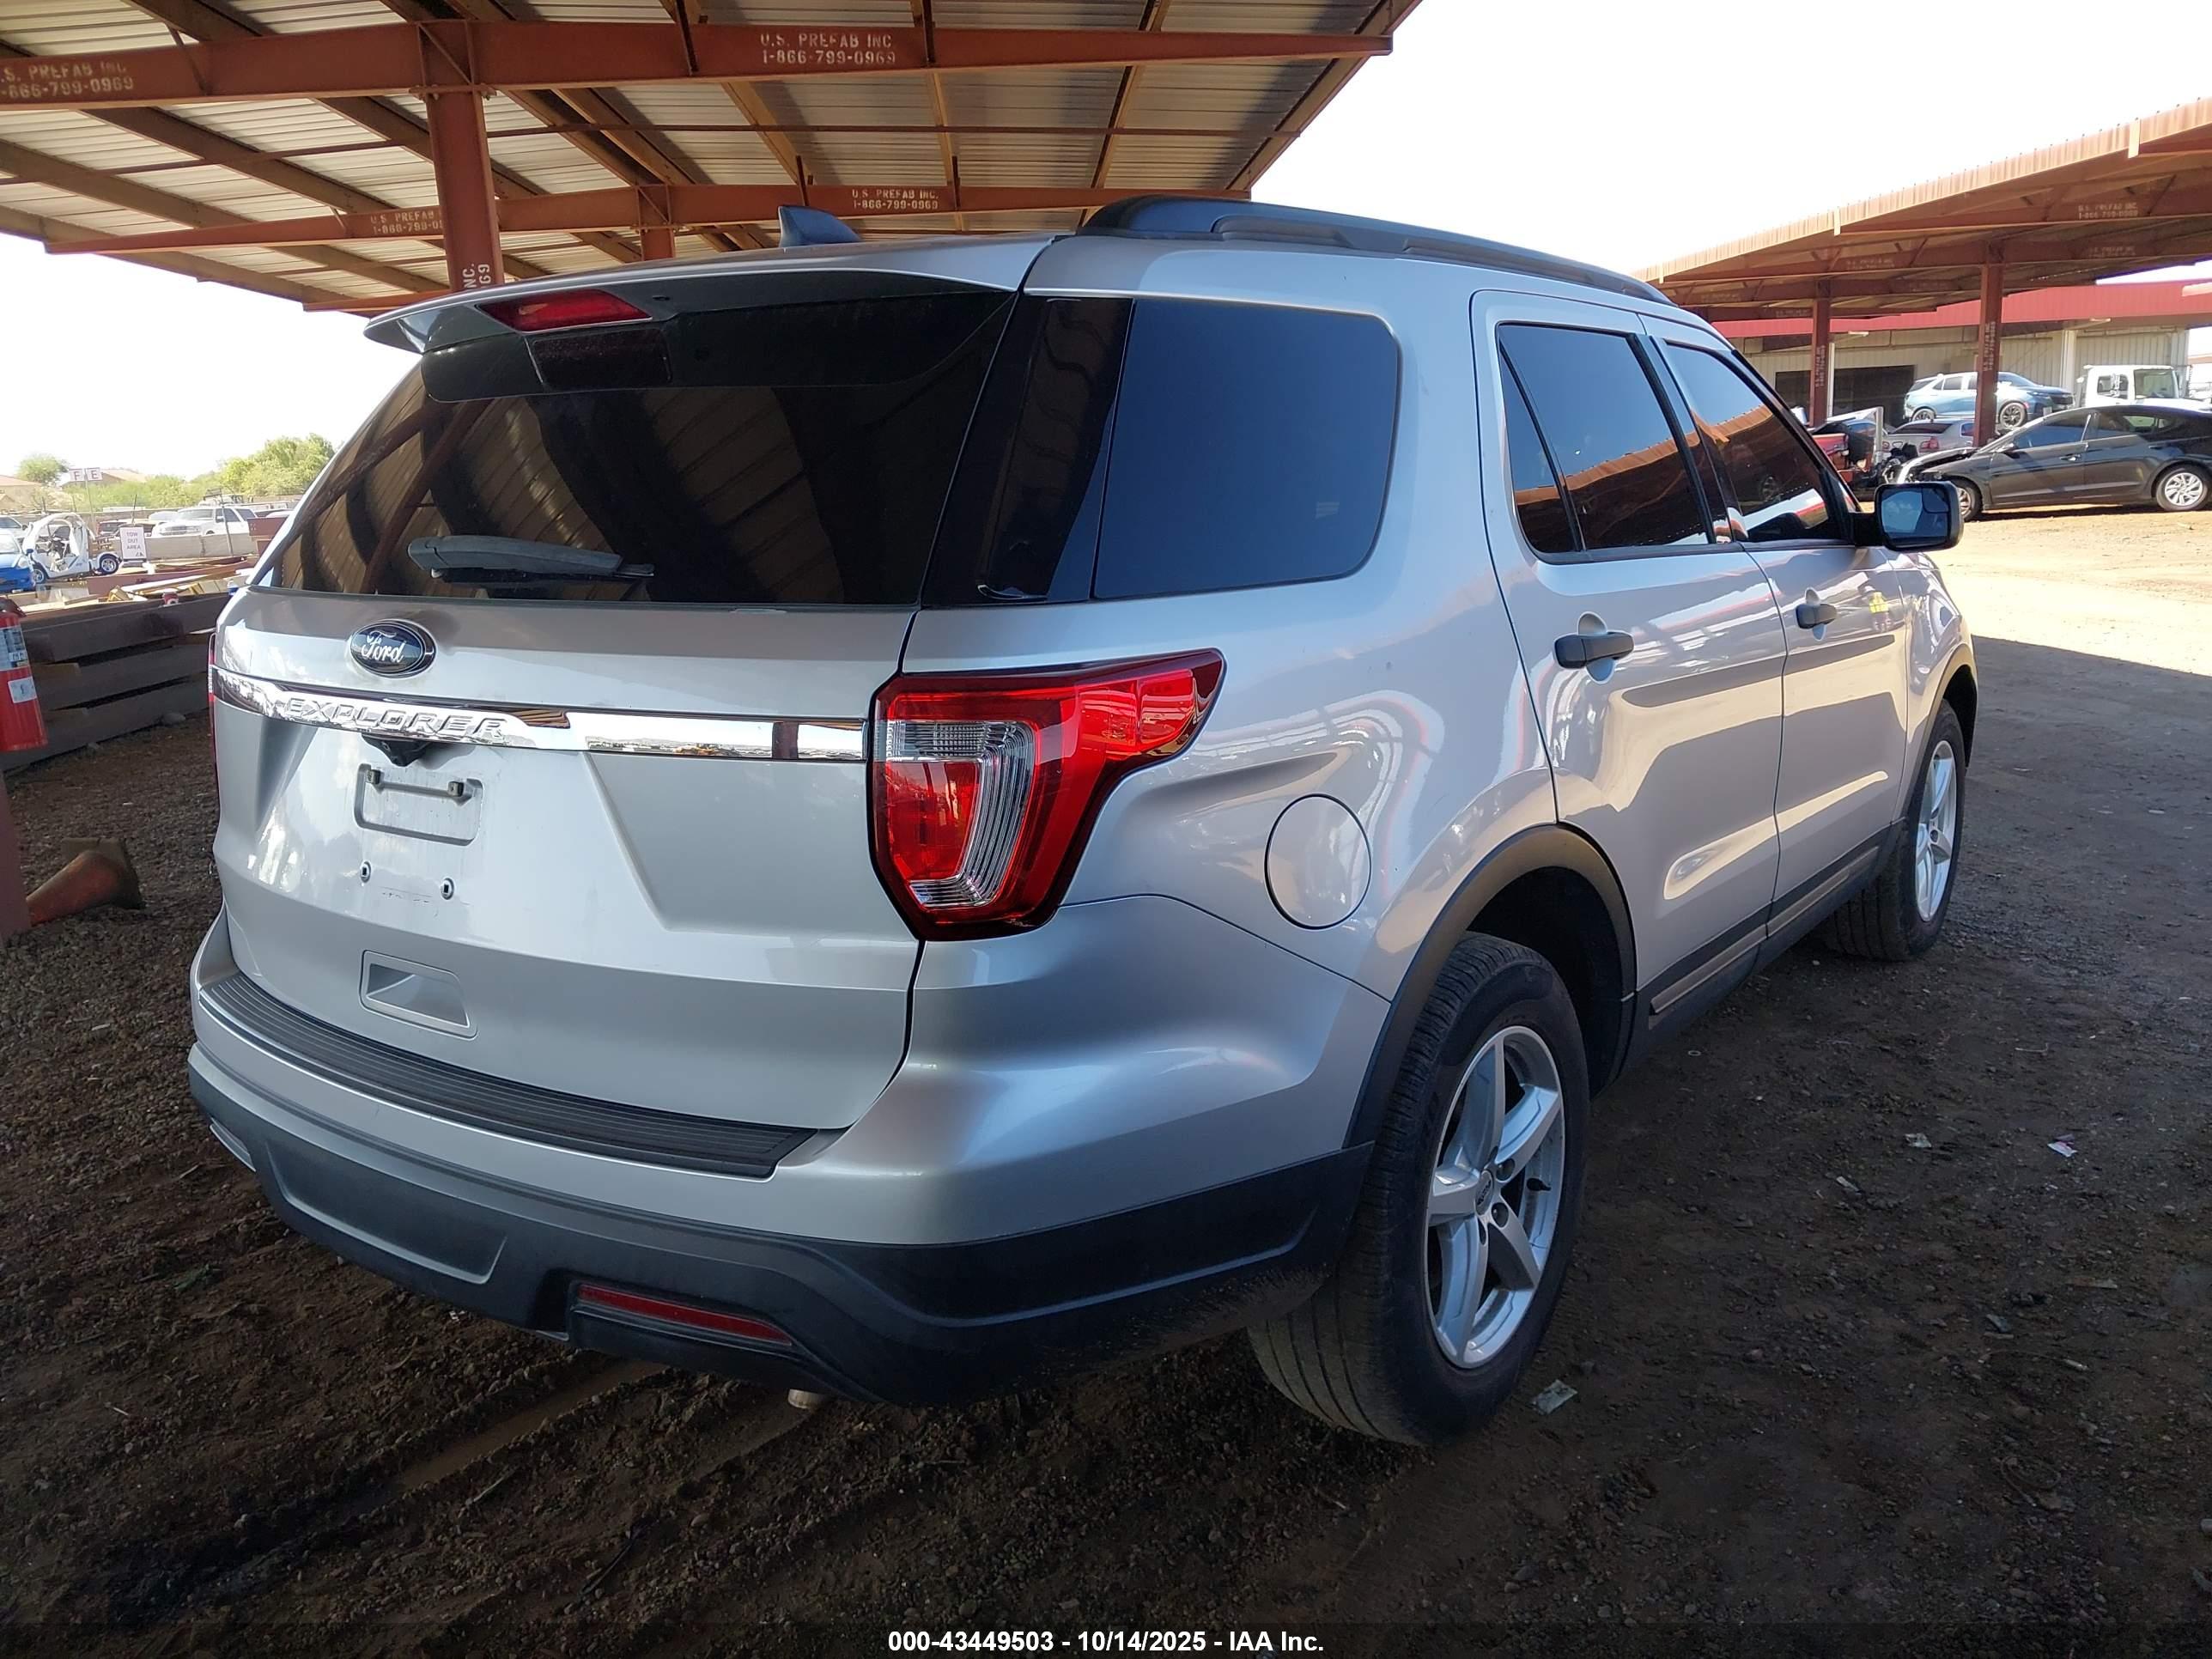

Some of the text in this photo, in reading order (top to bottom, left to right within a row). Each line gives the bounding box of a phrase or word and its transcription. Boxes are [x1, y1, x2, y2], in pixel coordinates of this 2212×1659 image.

[799, 33, 860, 48] PREFAB
[28, 62, 94, 79] PREFAB
[876, 188, 915, 199] PREFAB
[853, 199, 939, 210] 1-866-799-0969
[91, 470, 99, 479] E
[360, 629, 407, 665] Ford
[285, 696, 510, 743] EXPLORER
